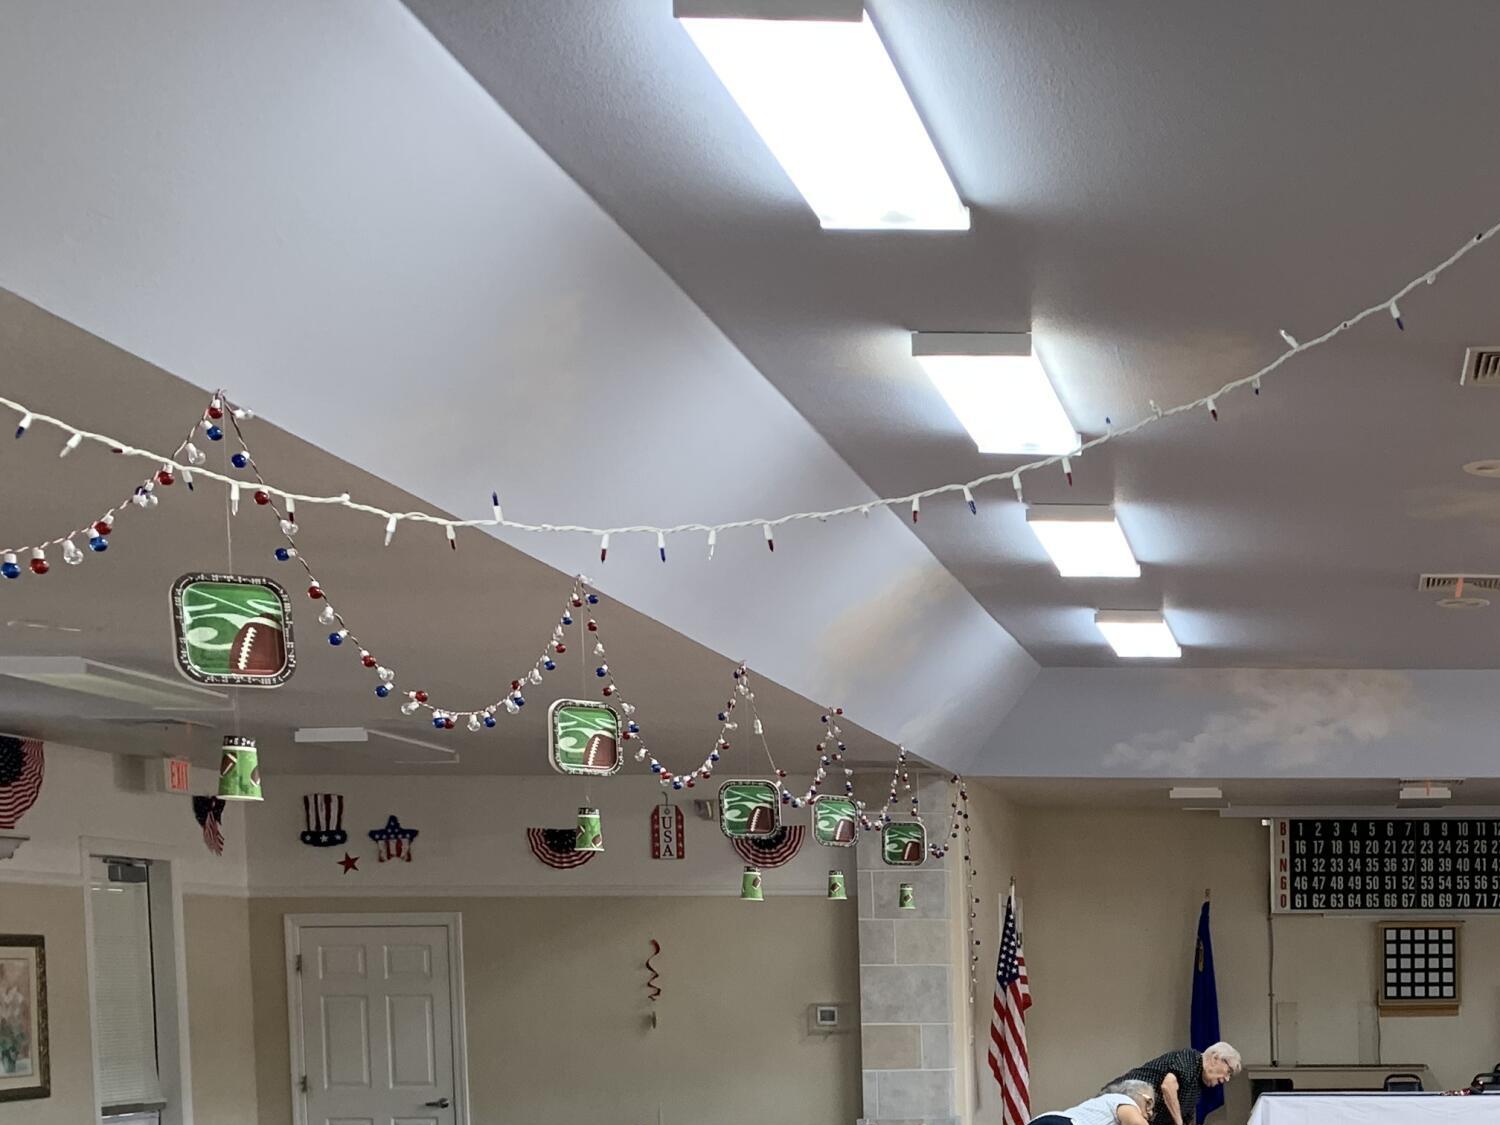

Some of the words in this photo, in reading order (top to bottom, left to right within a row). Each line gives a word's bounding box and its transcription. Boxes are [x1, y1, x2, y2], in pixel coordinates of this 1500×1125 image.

[1298, 822, 1303, 836] 1
[1314, 822, 1322, 836] 2
[1333, 822, 1340, 836] 3
[1350, 822, 1358, 836] 4
[1368, 822, 1376, 836] 5
[1386, 822, 1394, 836] 6
[1405, 822, 1412, 836] 7
[1423, 822, 1430, 836] 8
[1441, 822, 1448, 836] 9
[1457, 822, 1468, 836] 10
[1476, 822, 1485, 836] 11
[661, 816, 674, 857] USA
[1295, 840, 1306, 854] 16
[1313, 840, 1324, 854] 17
[1331, 840, 1342, 854] 18
[1349, 840, 1360, 854] 19
[1365, 840, 1379, 854] 20
[1384, 840, 1396, 854] 21
[1401, 840, 1414, 854] 22
[1420, 840, 1433, 854] 23
[1438, 840, 1451, 854] 24
[1455, 840, 1468, 854] 25
[1473, 840, 1487, 854] 26
[1294, 858, 1306, 872] 31
[1312, 858, 1325, 872] 32
[1330, 858, 1343, 872] 33
[1347, 858, 1361, 872] 34
[1365, 858, 1379, 872] 35
[1383, 858, 1397, 872] 36
[1401, 858, 1414, 872] 37
[1420, 858, 1433, 872] 38
[1438, 858, 1451, 872] 39
[1456, 858, 1469, 872] 40
[1474, 858, 1486, 872] 41
[1294, 876, 1307, 890] 46
[1311, 876, 1325, 890] 47
[1330, 876, 1343, 890] 48
[1347, 876, 1361, 890] 49
[1365, 876, 1379, 890] 50
[1384, 876, 1396, 890] 51
[1401, 876, 1414, 890] 52
[1420, 876, 1434, 890] 53
[1438, 876, 1451, 890] 54
[1456, 876, 1469, 890] 55
[1474, 875, 1487, 890] 56
[1294, 893, 1307, 908] 61
[1312, 893, 1325, 908] 62
[1330, 893, 1343, 908] 63
[1347, 893, 1361, 908] 64
[1365, 893, 1379, 908] 65
[1383, 893, 1397, 908] 66
[1401, 893, 1415, 908] 67
[1420, 893, 1434, 908] 68
[1438, 893, 1452, 908] 69
[1456, 893, 1470, 908] 70
[1475, 893, 1487, 908] 71
